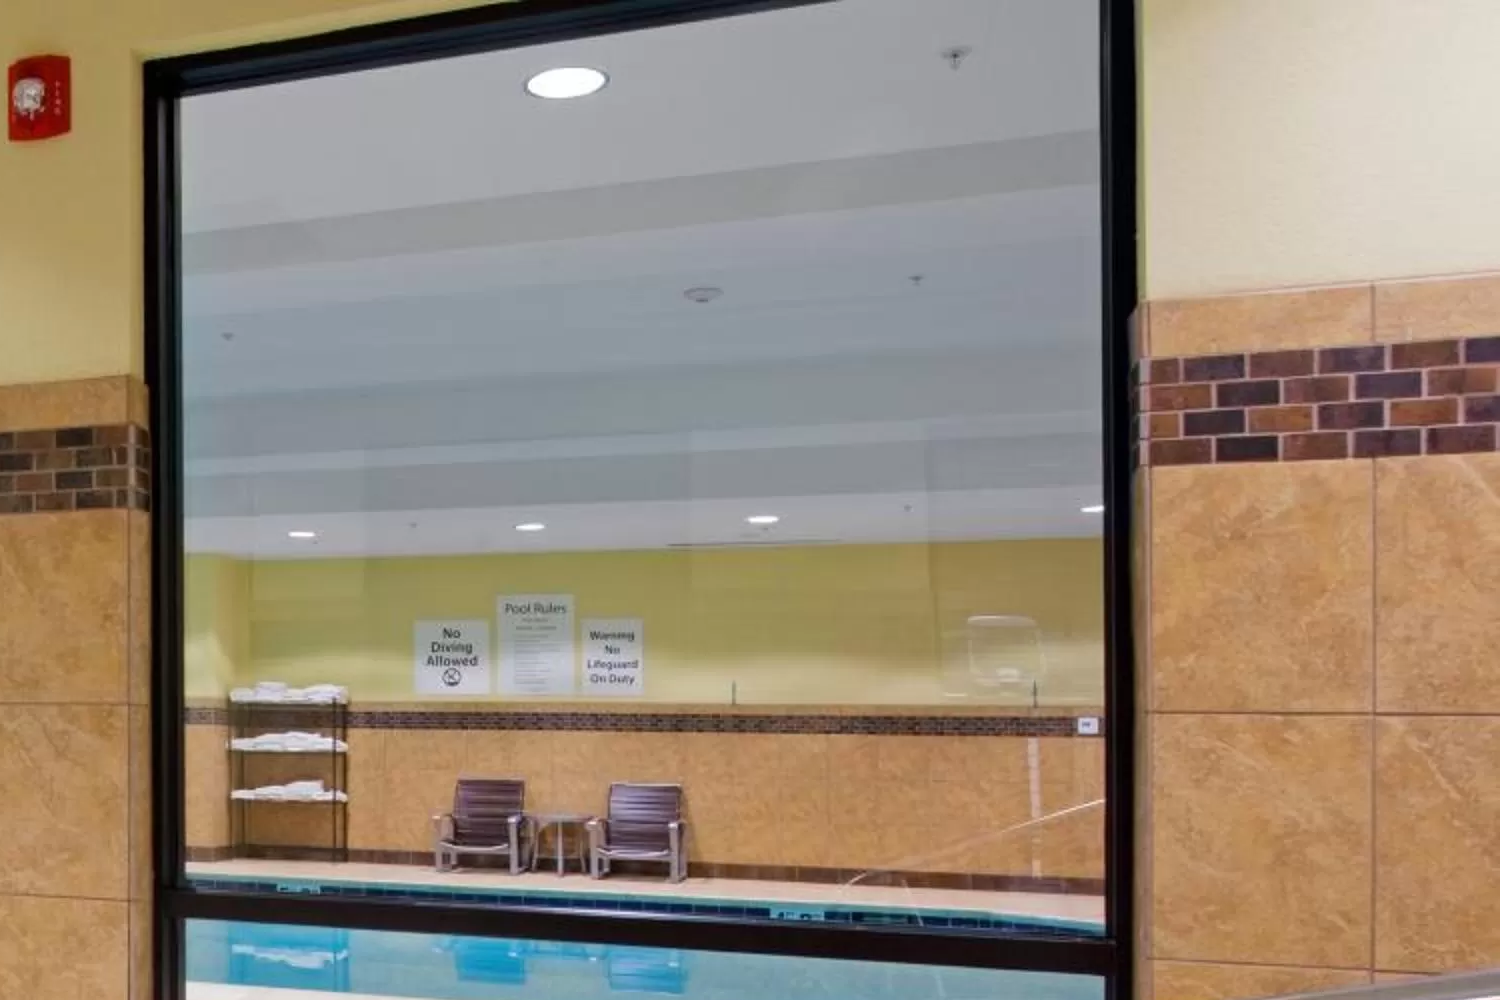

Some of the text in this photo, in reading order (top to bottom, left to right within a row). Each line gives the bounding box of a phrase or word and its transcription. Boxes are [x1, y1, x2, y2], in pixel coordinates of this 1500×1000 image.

[504, 602, 566, 614] Pool Rules
[443, 627, 461, 639] No
[589, 630, 635, 643] Warning
[431, 641, 473, 655] Diving
[604, 644, 621, 654] No
[426, 655, 479, 667] Allowed
[587, 659, 639, 671] Lifeguard
[589, 673, 635, 686] On Duty
